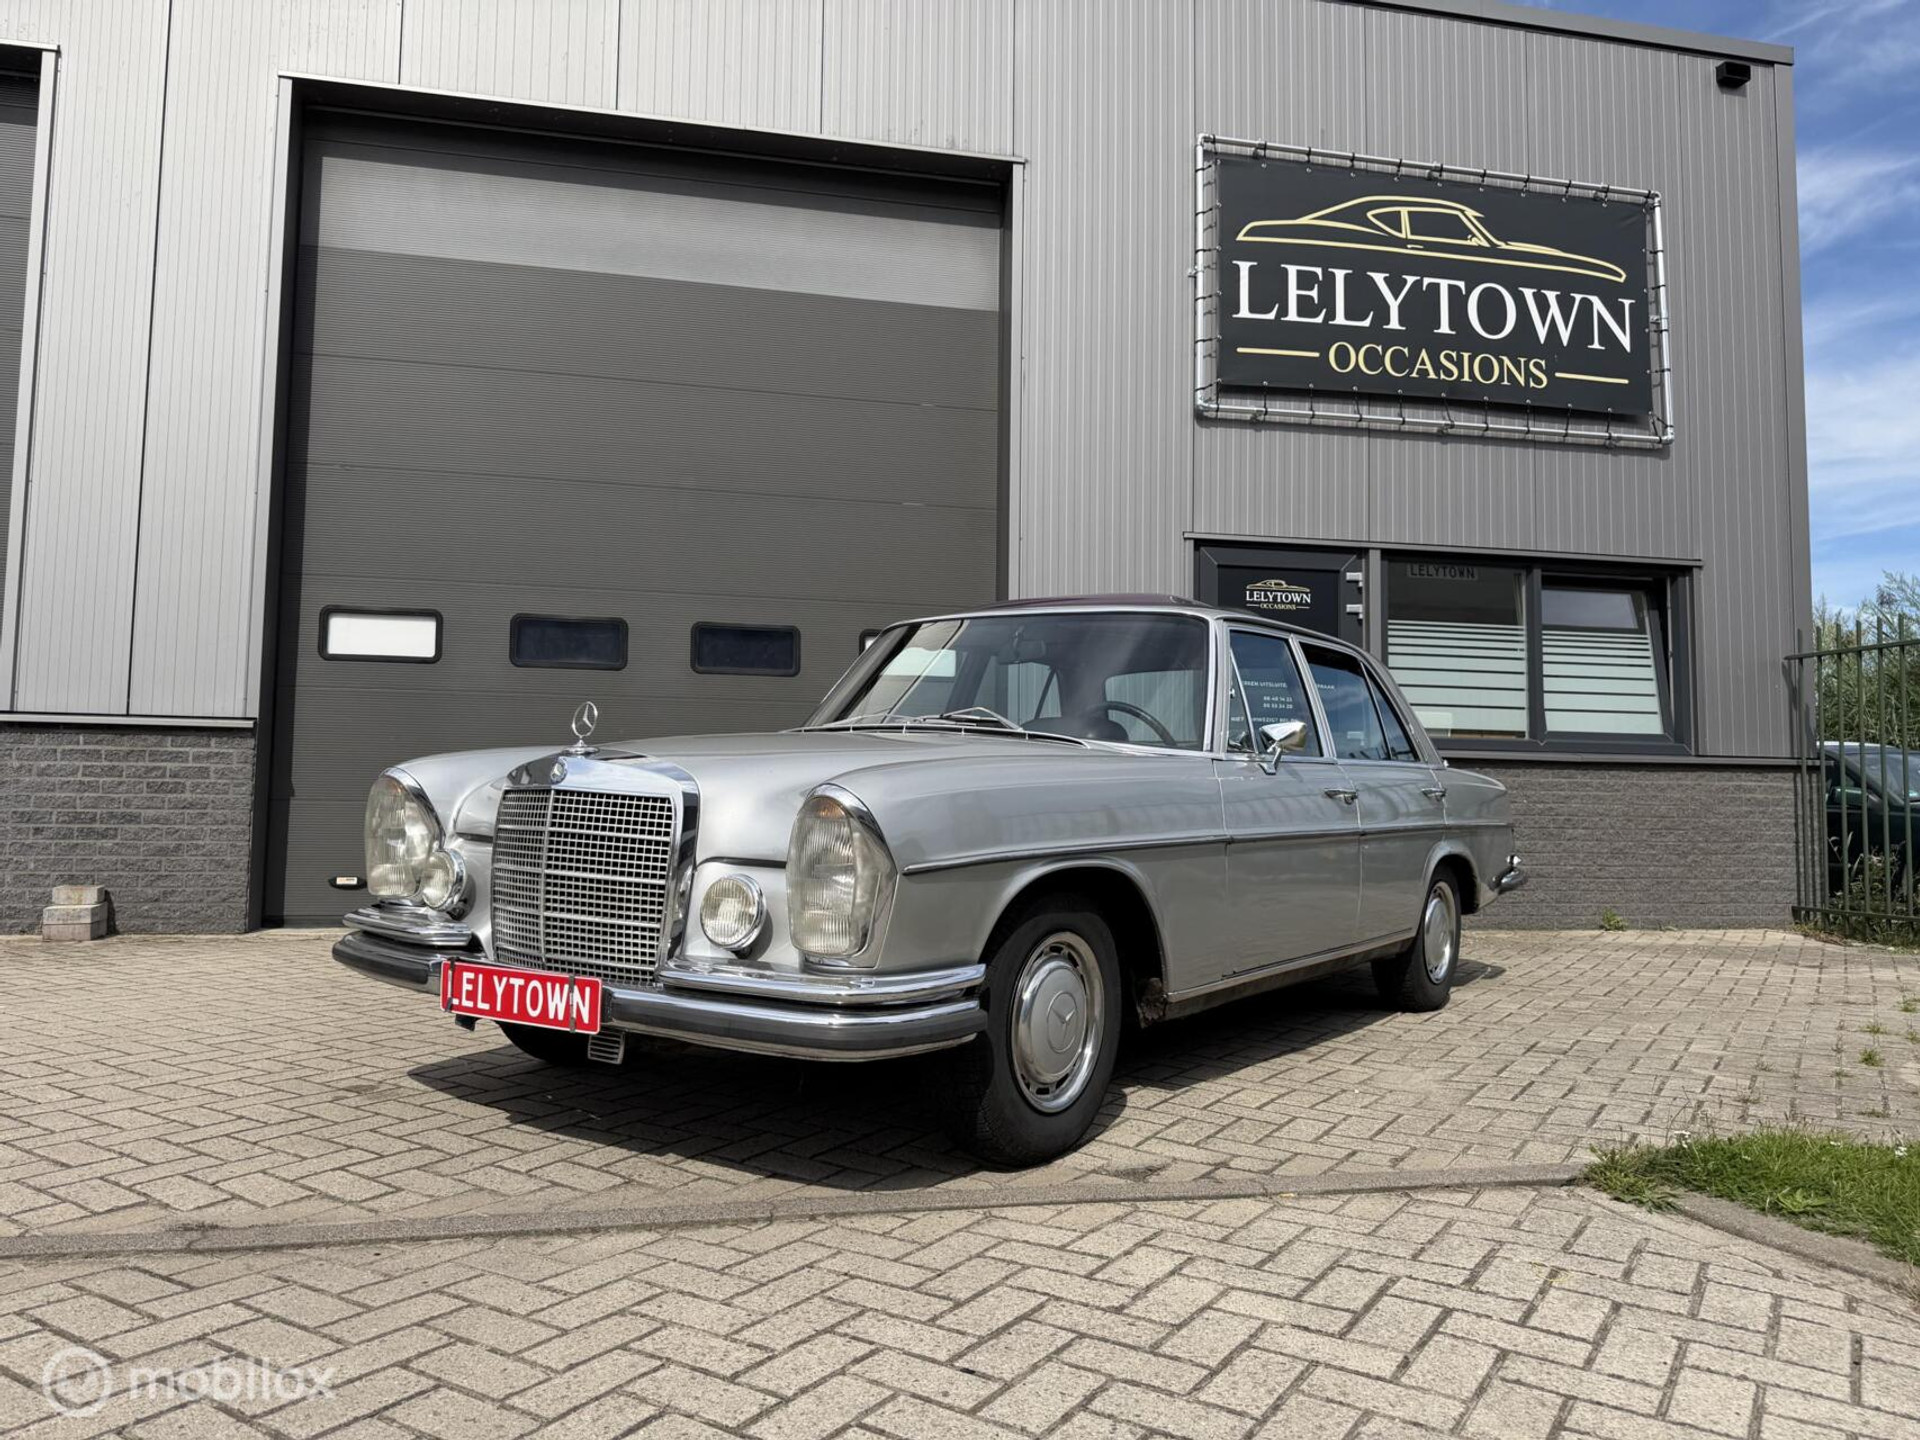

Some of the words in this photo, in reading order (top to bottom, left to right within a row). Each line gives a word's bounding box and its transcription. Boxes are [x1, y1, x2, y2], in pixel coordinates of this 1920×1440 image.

[1232, 260, 1635, 353] LELYTOWN
[1329, 341, 1548, 389] OCCASIONS
[1410, 563, 1476, 579] LELYTOWN
[1246, 590, 1311, 604] LELYTOWN
